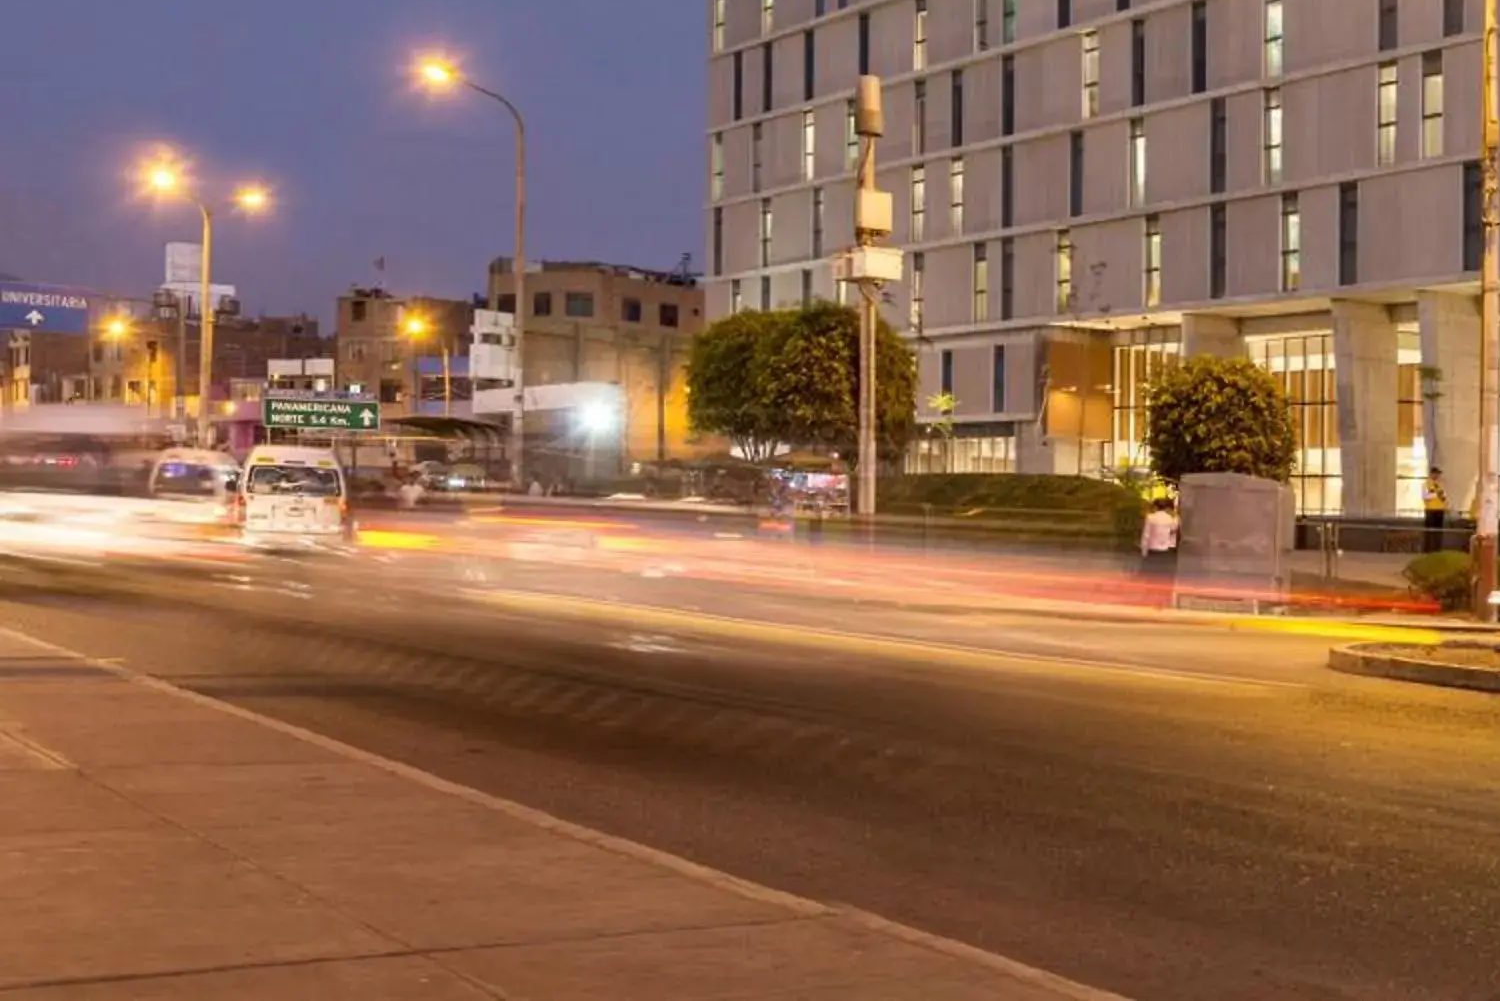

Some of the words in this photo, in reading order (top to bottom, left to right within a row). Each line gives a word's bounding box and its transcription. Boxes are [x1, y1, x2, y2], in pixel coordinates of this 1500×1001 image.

[1, 290, 88, 309] UNIVERSITARIA
[271, 401, 352, 414] PANAMERICANA
[271, 414, 305, 425] NORTE
